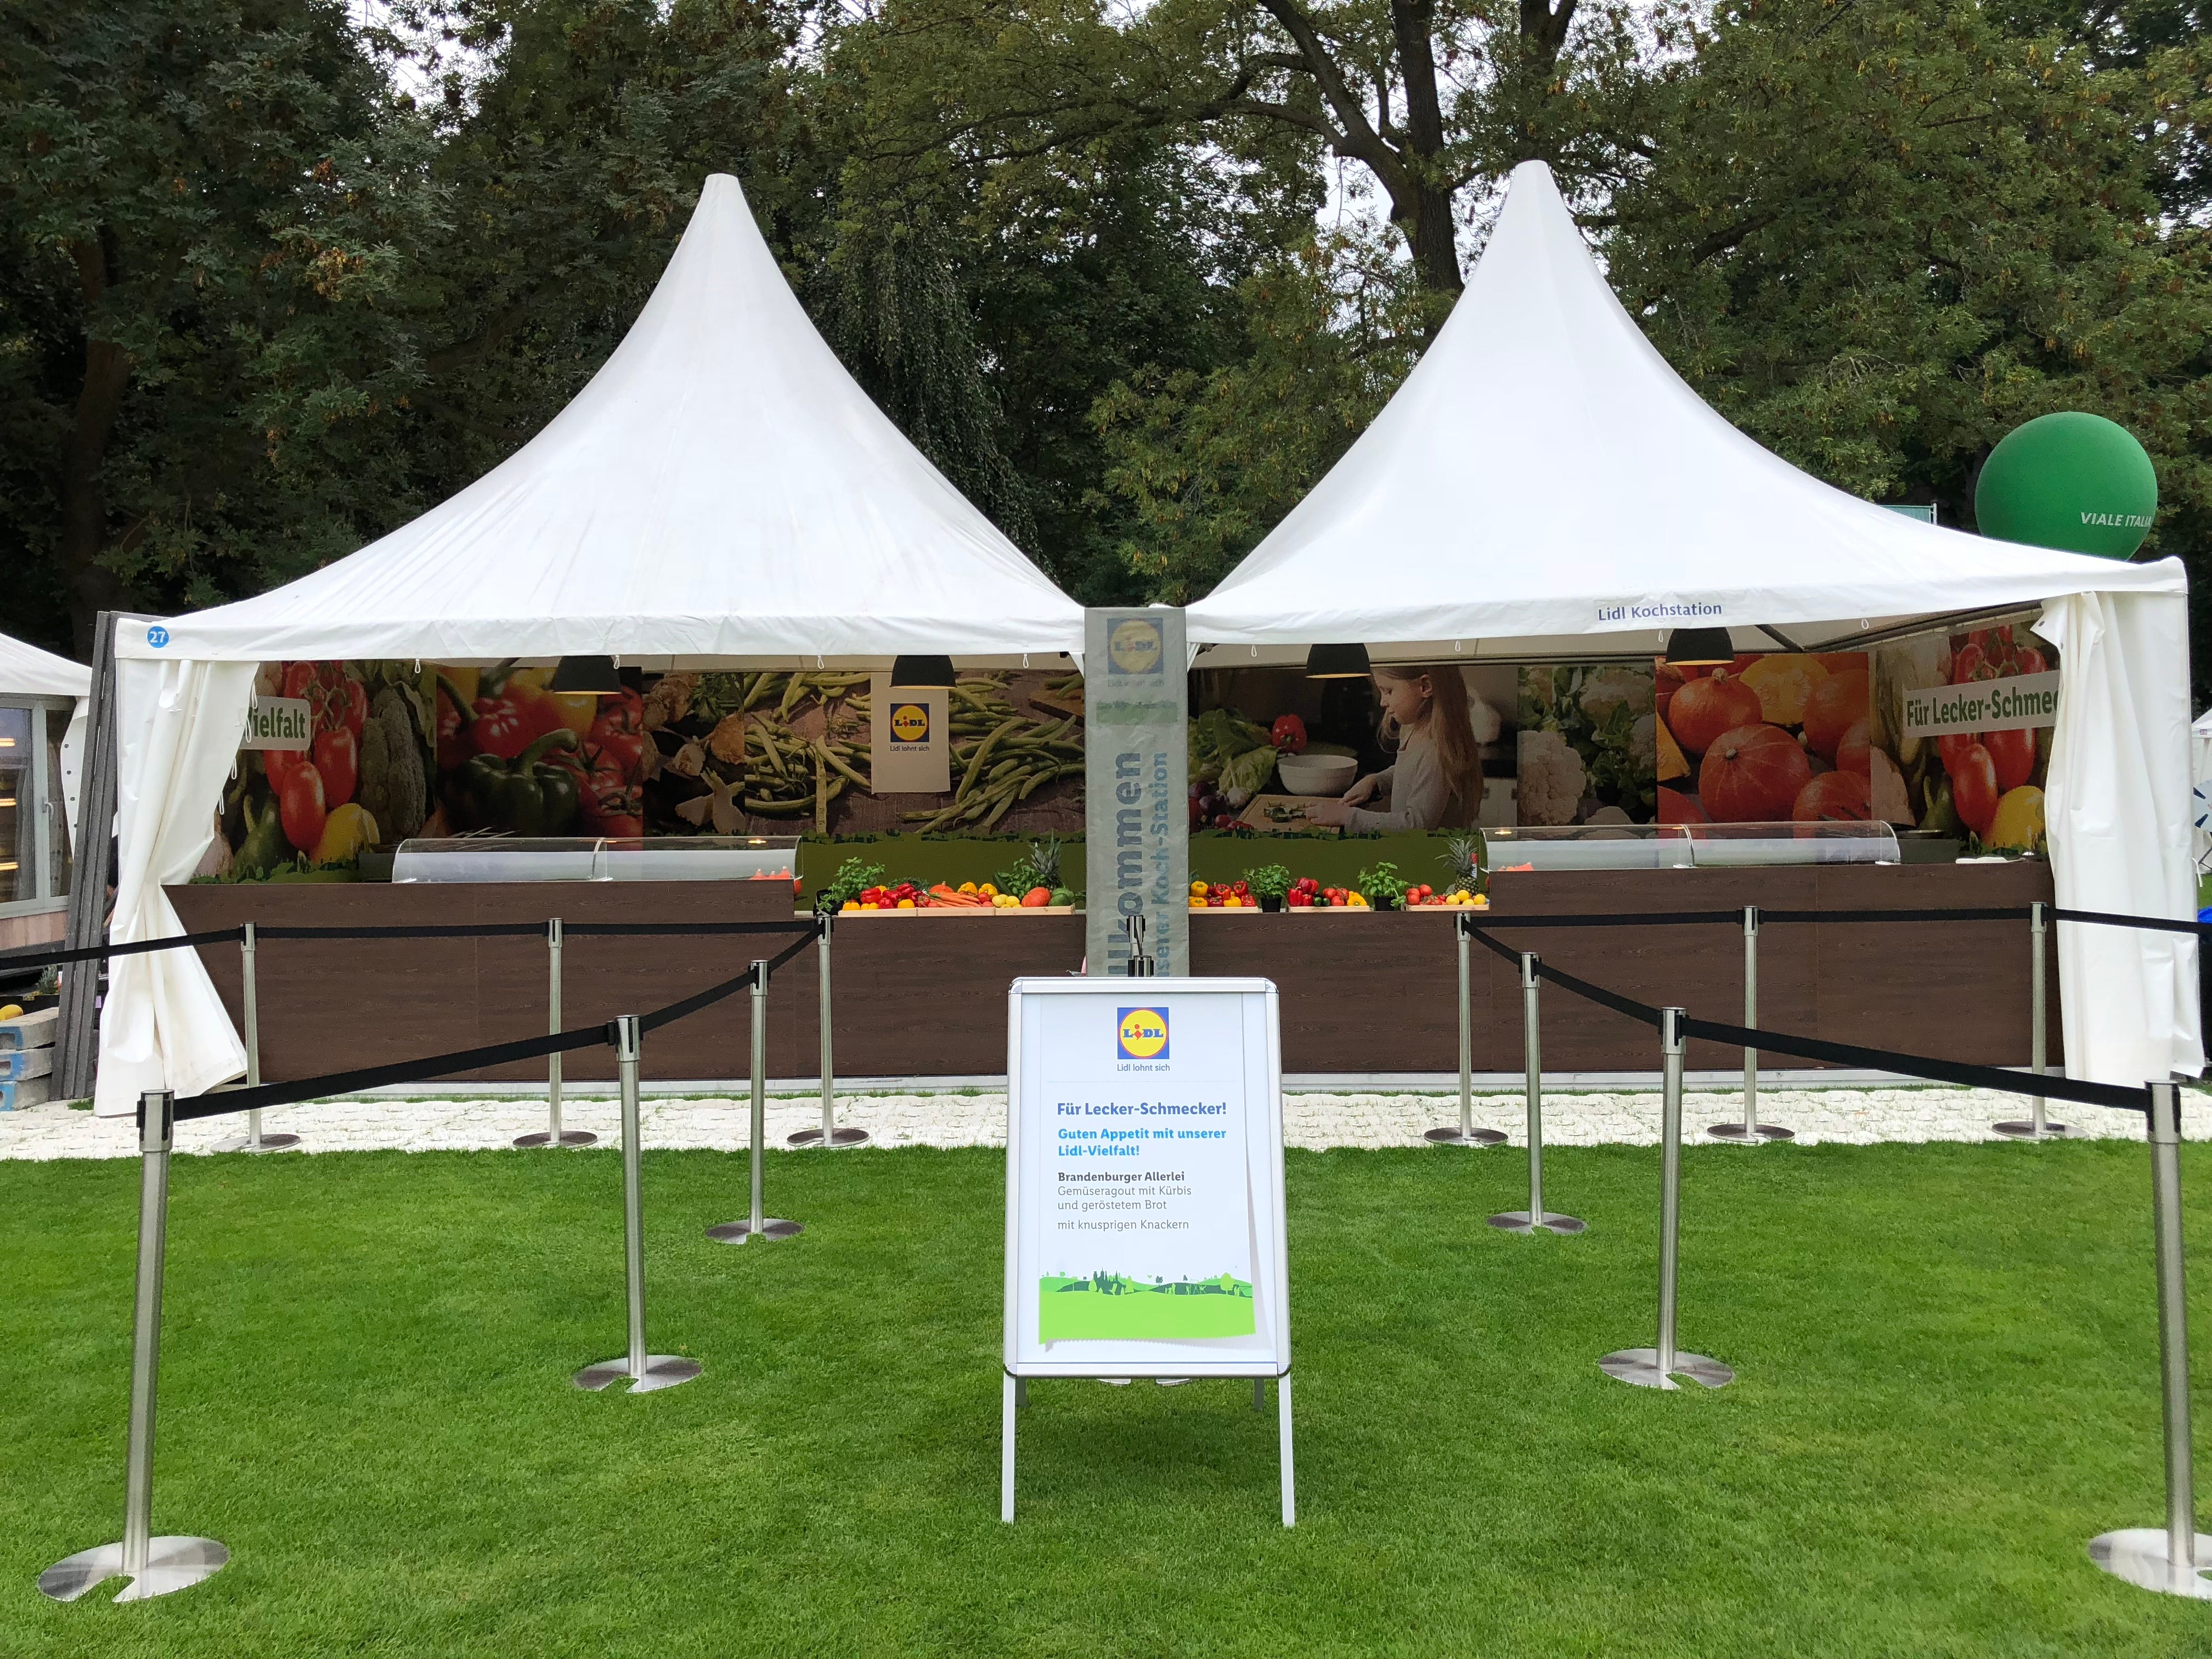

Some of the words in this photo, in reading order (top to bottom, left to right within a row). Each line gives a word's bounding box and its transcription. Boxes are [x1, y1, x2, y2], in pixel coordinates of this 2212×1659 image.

[2080, 512, 2124, 526] VIALE
[2124, 515, 2152, 527] ITALIA
[1598, 607, 1626, 621] Lidl
[1631, 602, 1722, 619] Kochstation
[149, 631, 166, 643] 27
[1906, 698, 1929, 727] Für
[1148, 753, 1170, 905] Koch-Station
[1117, 1063, 1131, 1071] Lidl
[1133, 1063, 1153, 1071] lohnt
[1155, 1063, 1170, 1071] sich
[1057, 1102, 1081, 1115] Für
[1085, 1102, 1227, 1115] Lecker-Schmecker!
[1058, 1128, 1097, 1139] Guten
[1100, 1128, 1149, 1142] Appetit
[1153, 1128, 1174, 1139] mit
[1178, 1129, 1227, 1139] unserer
[1058, 1145, 1140, 1156] Lidl-Vielfalt!
[1058, 1172, 1142, 1184] Brandenburger
[1144, 1171, 1184, 1181] Allerlei
[1058, 1186, 1136, 1198] Gemüseragout
[1138, 1186, 1156, 1195] mit
[1159, 1186, 1192, 1195] Kürbis
[1058, 1200, 1079, 1210] und
[1081, 1200, 1141, 1212] geröstetem
[1144, 1200, 1167, 1210] Brot
[1058, 1220, 1075, 1229] mit
[1078, 1219, 1137, 1232] knusprigen
[1141, 1219, 1189, 1229] Knackern
